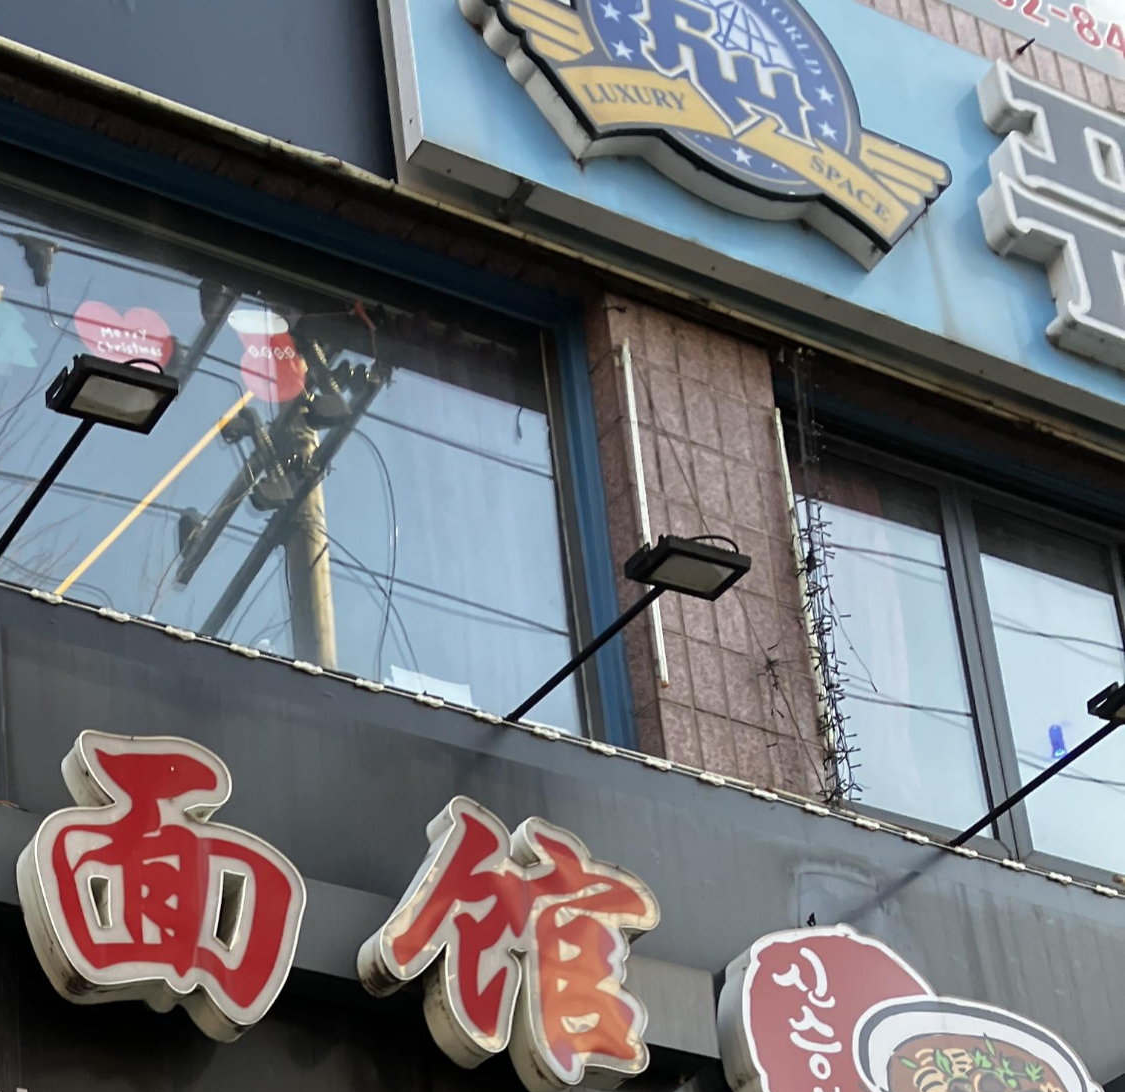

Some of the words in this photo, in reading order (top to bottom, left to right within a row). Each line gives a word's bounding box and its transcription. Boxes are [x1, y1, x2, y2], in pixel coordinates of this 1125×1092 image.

[581, 83, 687, 112] LUXURY
[810, 154, 891, 222] SPACE
[101, 327, 147, 341] Merry
[97, 341, 163, 357] Christmas
